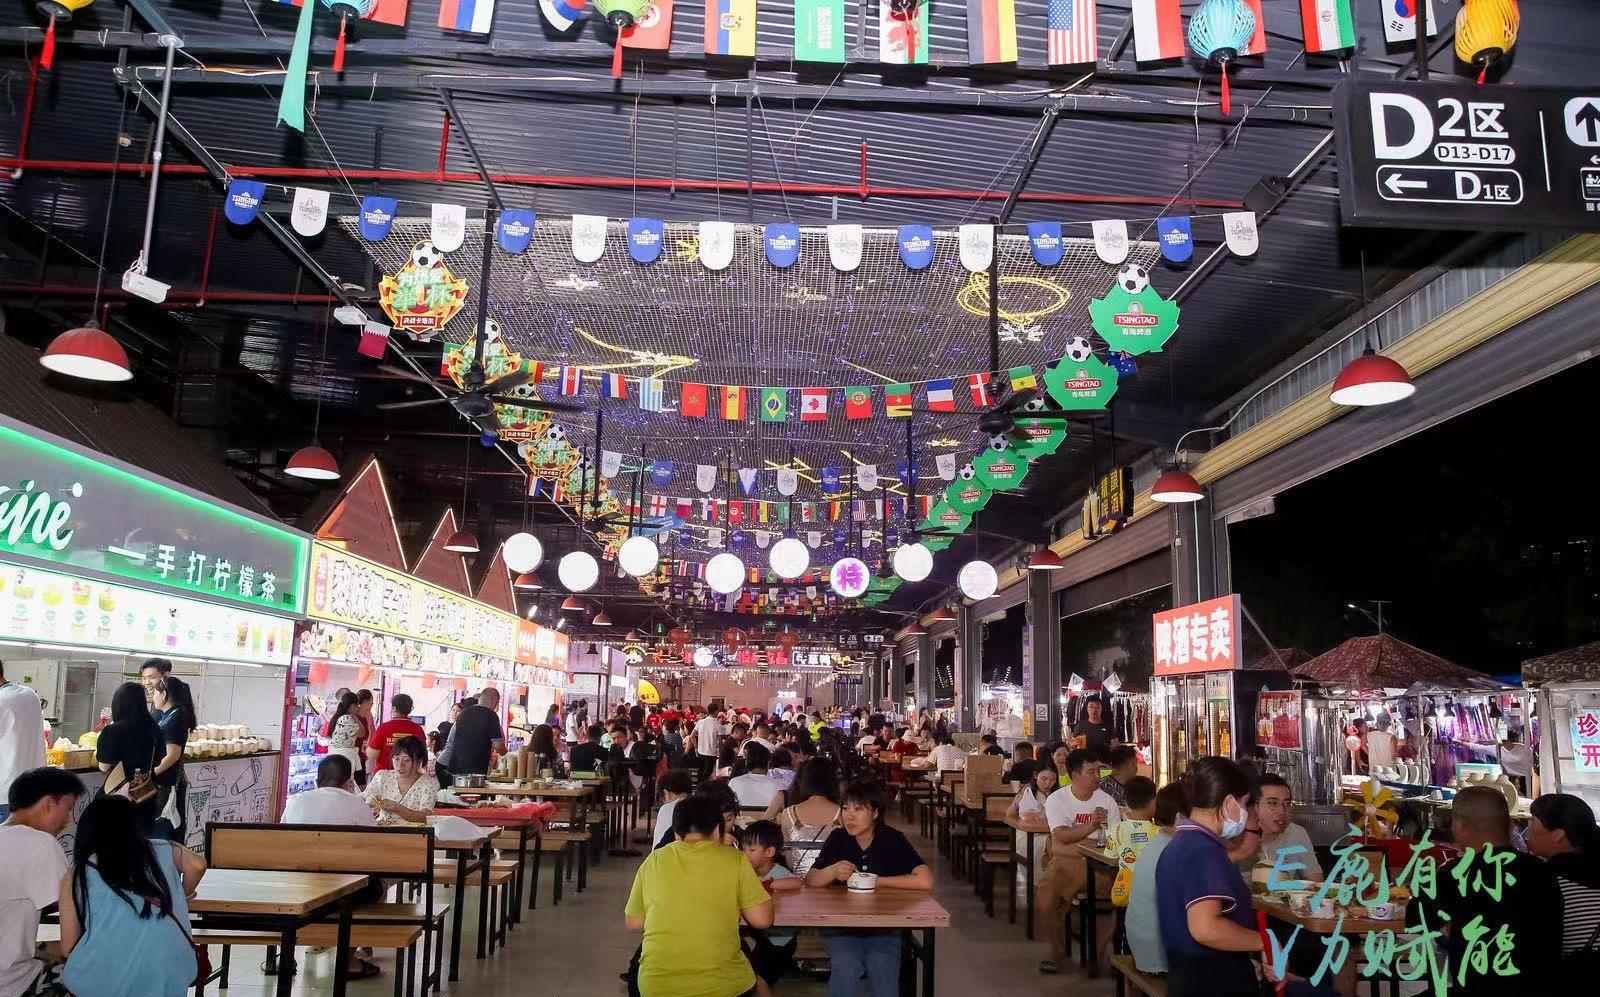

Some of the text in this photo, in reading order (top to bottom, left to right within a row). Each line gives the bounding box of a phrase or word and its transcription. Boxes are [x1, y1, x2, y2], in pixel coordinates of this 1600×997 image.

[1369, 92, 1509, 160] D2区
[1437, 145, 1511, 161] D13-D17
[1454, 171, 1511, 200] D1区
[502, 224, 530, 234] TSINGTAO
[1033, 237, 1060, 246] TSINGTAO
[1163, 233, 1189, 242] TSINGTAO
[403, 317, 435, 325] 决战卡塔尔
[1117, 315, 1156, 325] TSINGTAO
[1121, 327, 1152, 336] 青岛啤酒
[1066, 380, 1100, 388] TSINGTAO
[836, 563, 864, 592] 特
[1155, 606, 1231, 668] 啤酒专卖
